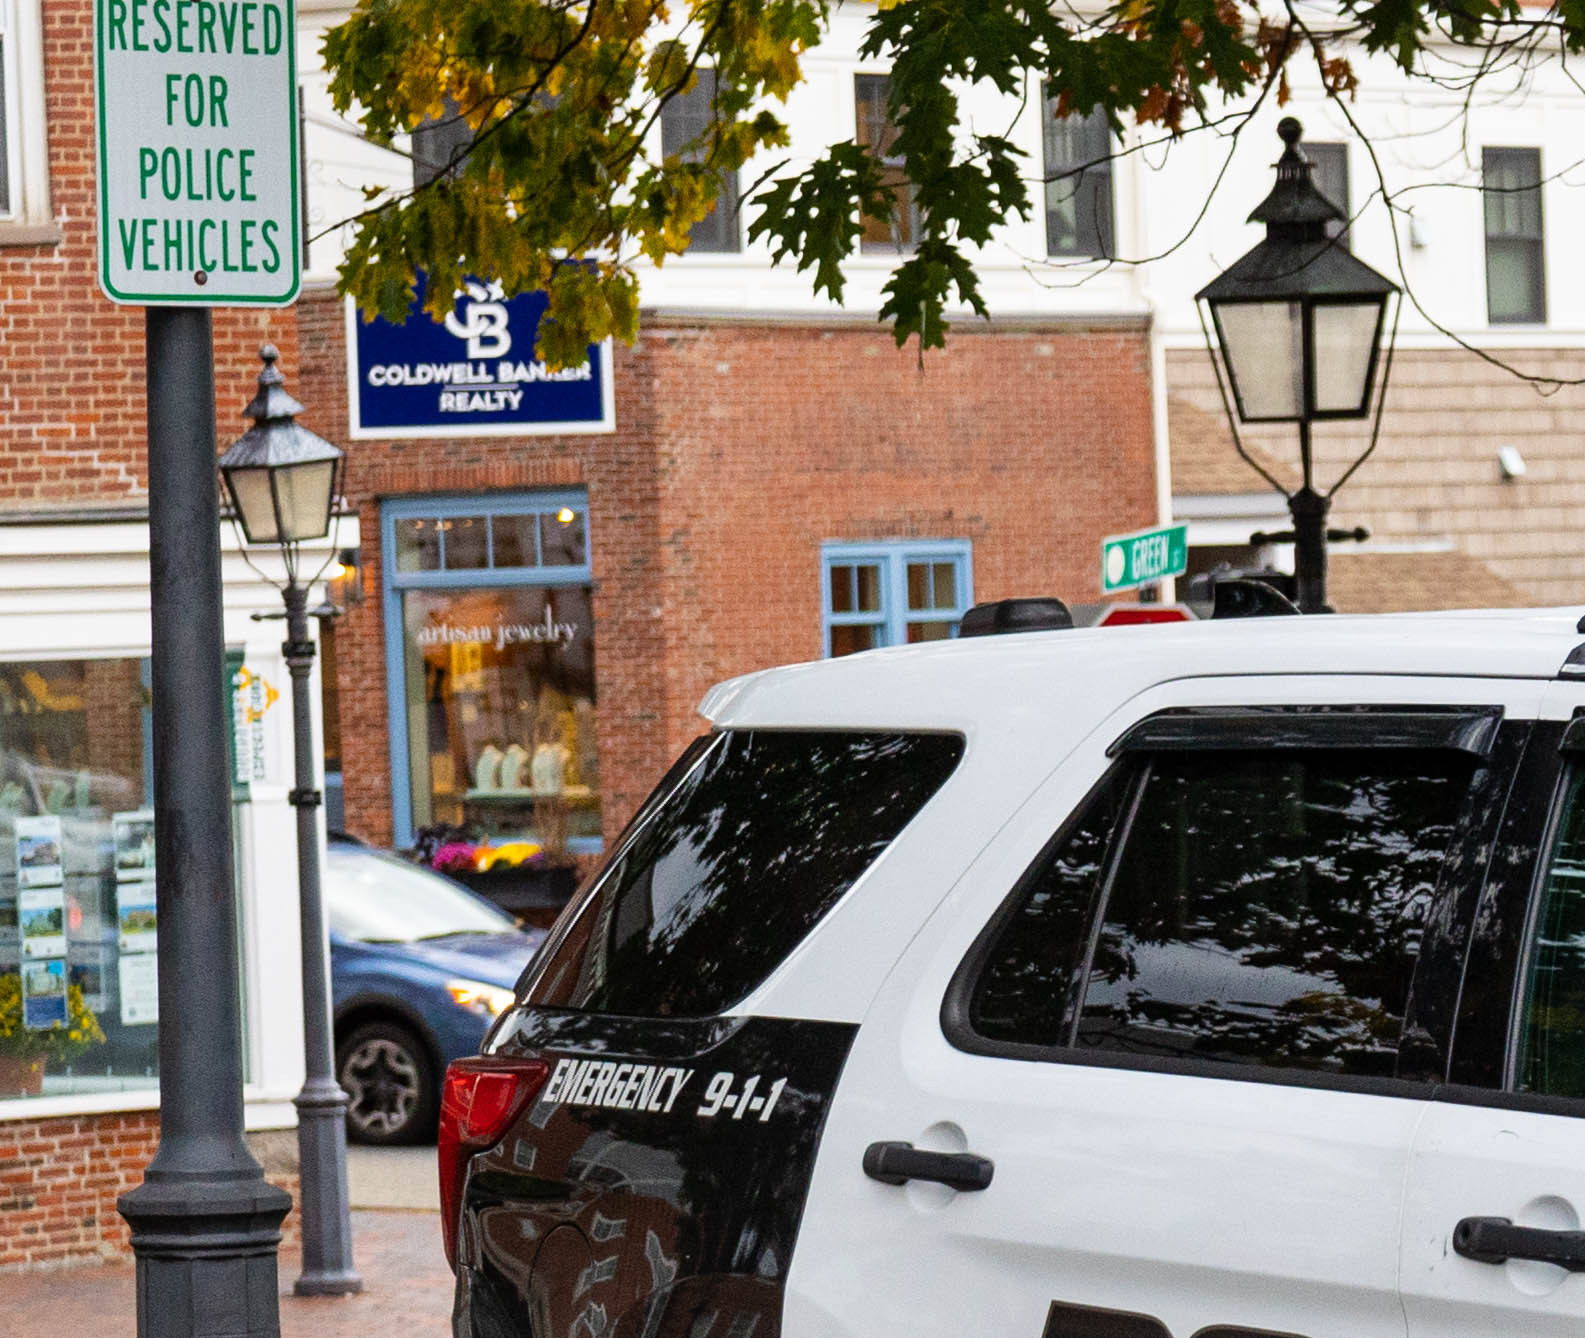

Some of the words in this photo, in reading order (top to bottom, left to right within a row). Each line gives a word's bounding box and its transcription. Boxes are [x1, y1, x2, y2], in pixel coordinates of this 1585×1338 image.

[108, 0, 281, 55] RESERVED
[166, 73, 228, 127] FOR
[139, 147, 256, 201] POLICE
[118, 219, 280, 273] VEHICLES
[368, 362, 494, 386] COLDWELL
[439, 390, 523, 412] REALTY
[1132, 533, 1170, 580] GREEN
[416, 623, 493, 645] artisan
[495, 604, 578, 651] jewelry
[542, 1058, 695, 1113] EMERGENCY
[697, 1071, 788, 1122] 9-1-1
